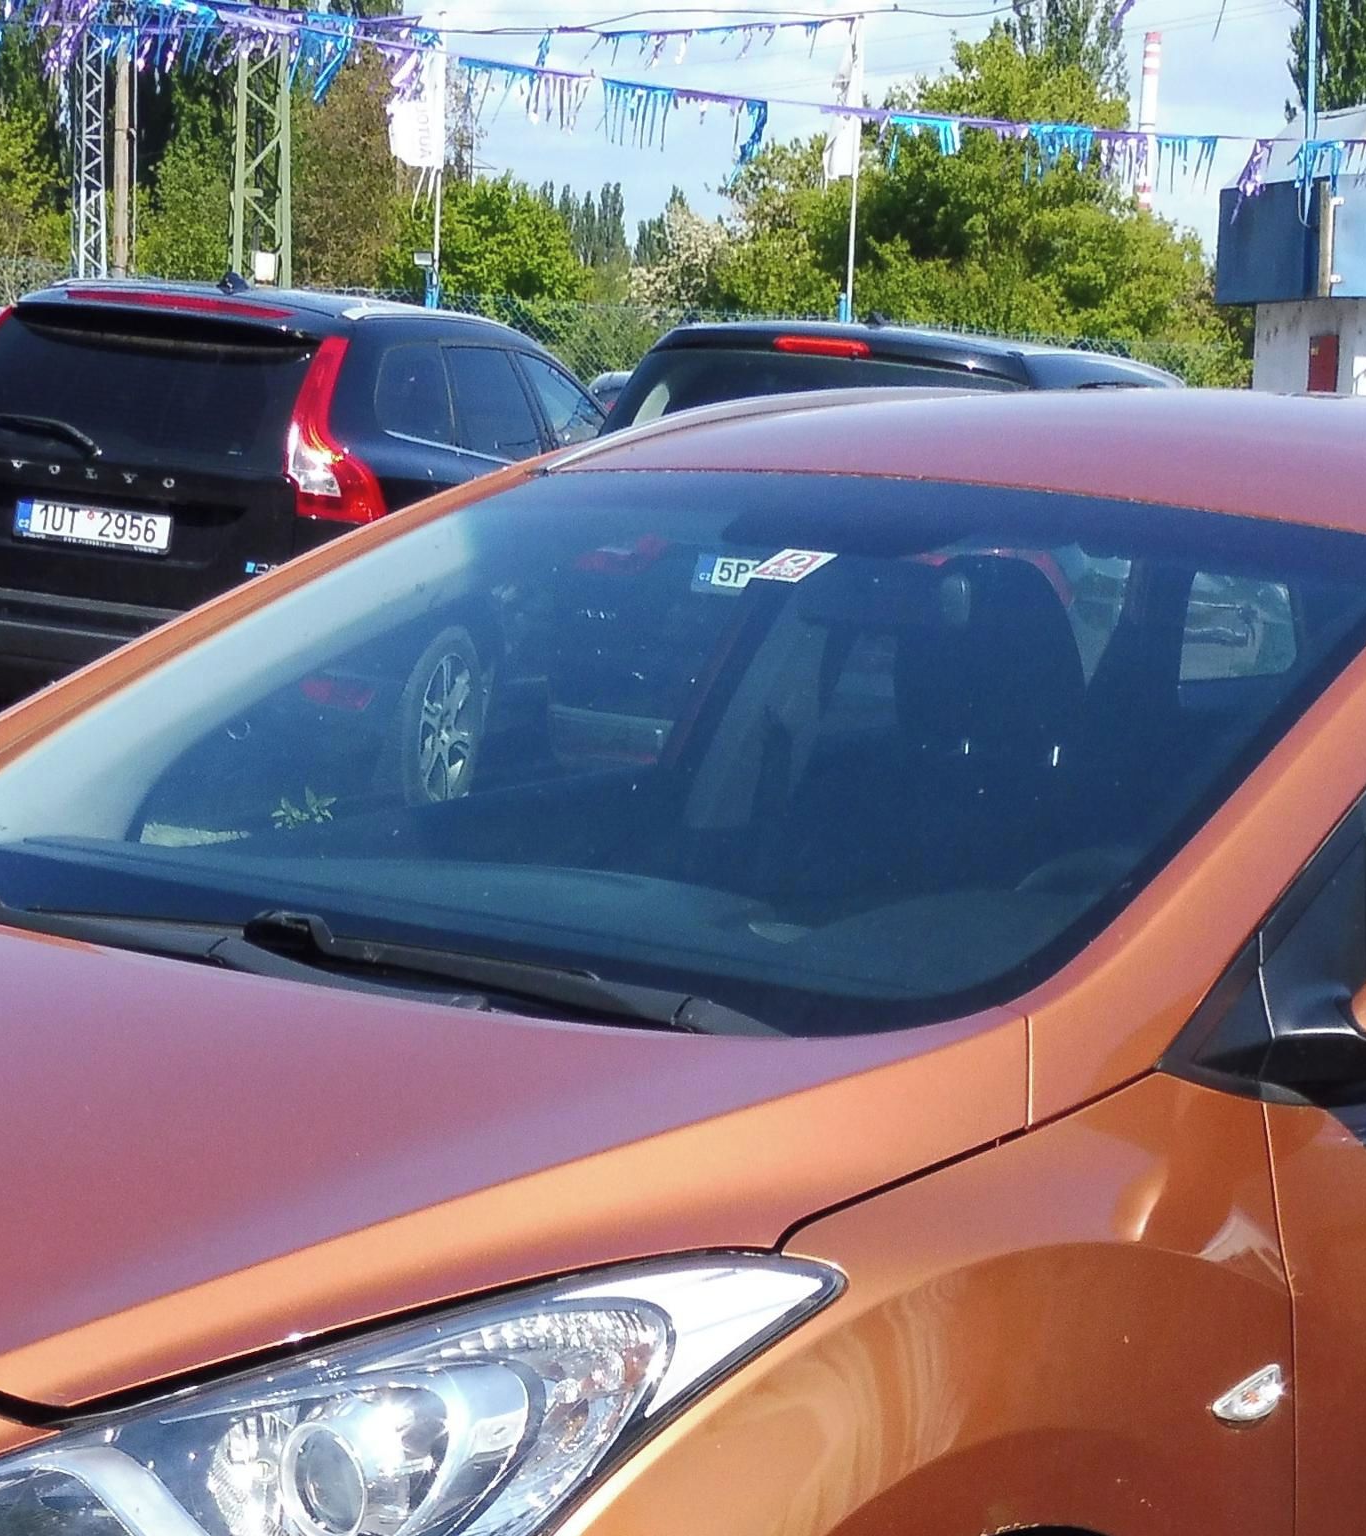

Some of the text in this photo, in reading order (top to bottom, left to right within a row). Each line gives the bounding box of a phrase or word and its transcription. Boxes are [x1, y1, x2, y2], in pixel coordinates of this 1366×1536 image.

[11, 458, 175, 487] VOLVO
[39, 504, 79, 533] 1UT
[98, 511, 158, 543] 2956
